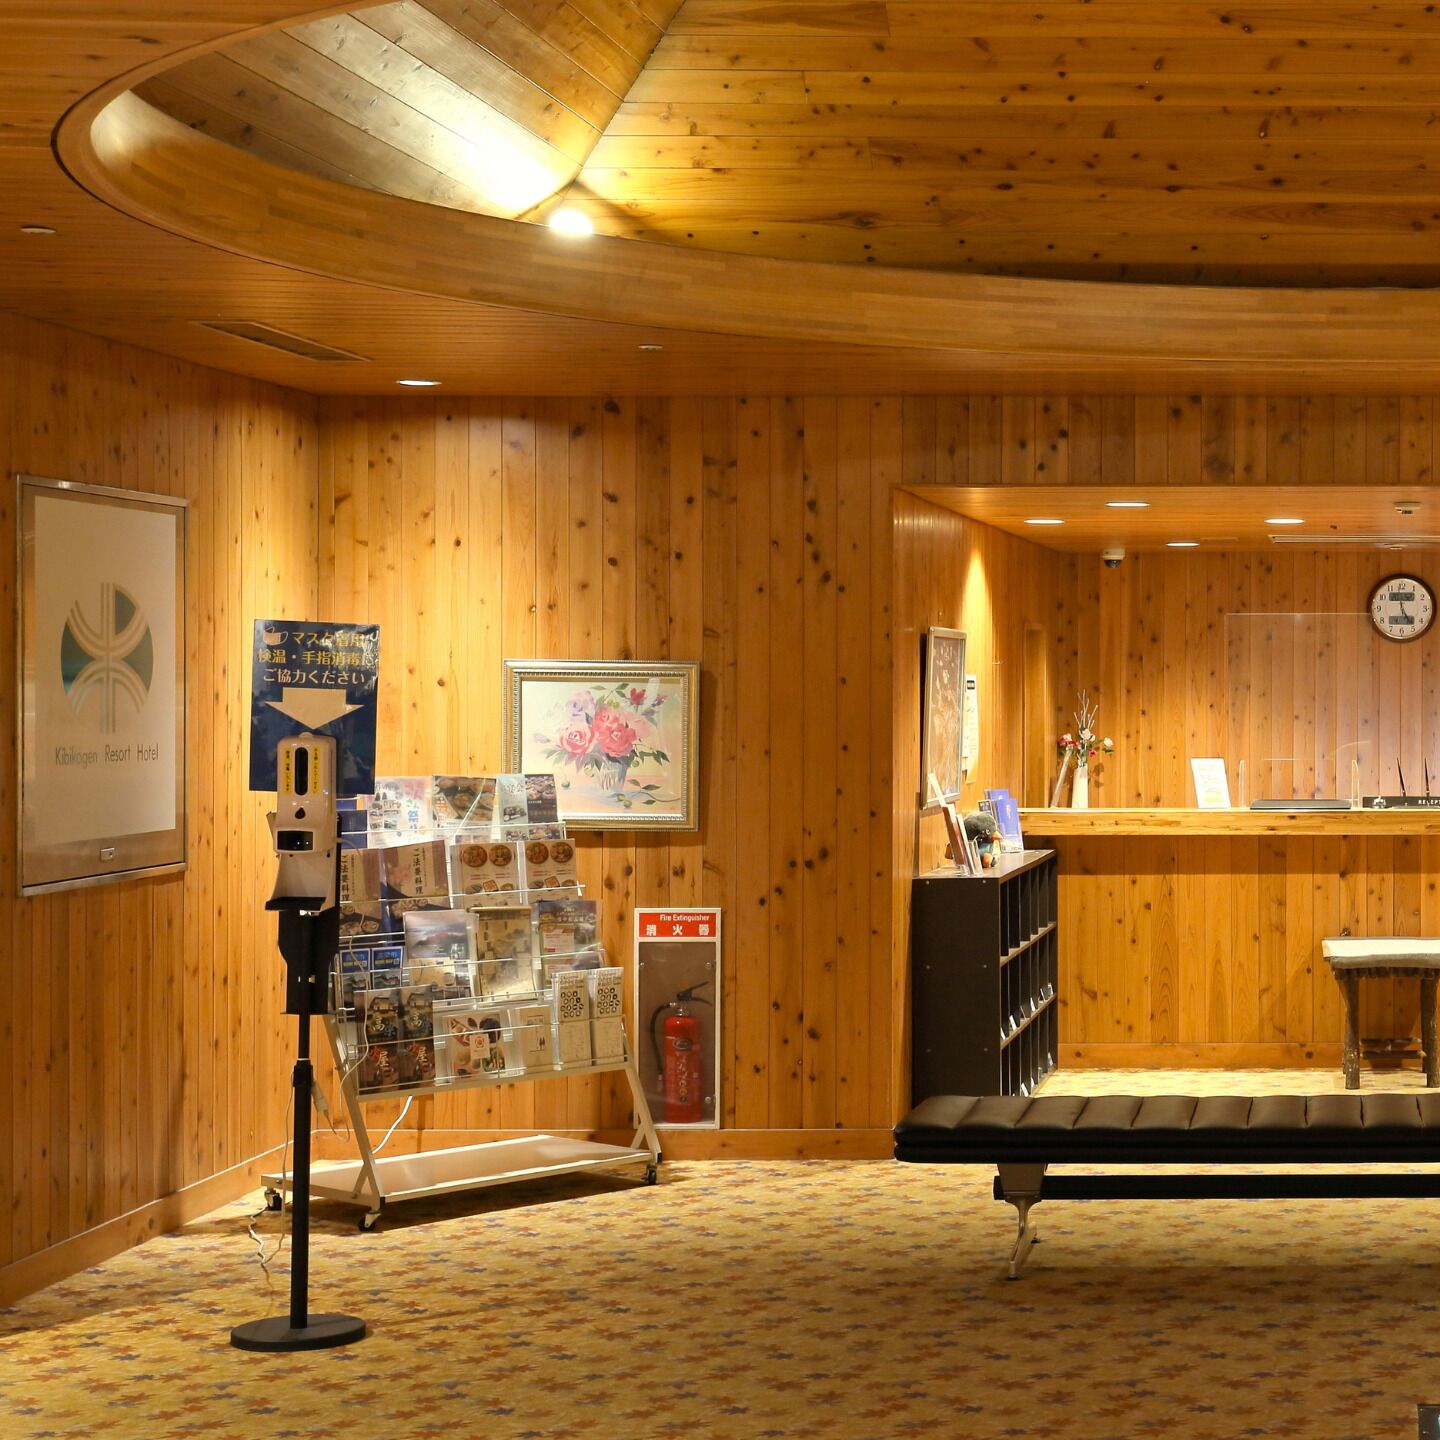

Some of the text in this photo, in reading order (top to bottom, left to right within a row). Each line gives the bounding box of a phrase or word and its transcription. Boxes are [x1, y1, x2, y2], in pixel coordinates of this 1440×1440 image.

[1398, 583, 1406, 591] 12
[1379, 593, 1386, 601] 10
[1420, 593, 1425, 601] 2
[1418, 617, 1424, 625] 4
[1399, 627, 1405, 635] 6
[1410, 625, 1416, 633] 5
[263, 668, 365, 685] ご協力ください
[55, 743, 159, 769] Kibikogen Resort Hotel
[673, 914, 710, 923] Extinguisher
[646, 923, 710, 937] 消火器
